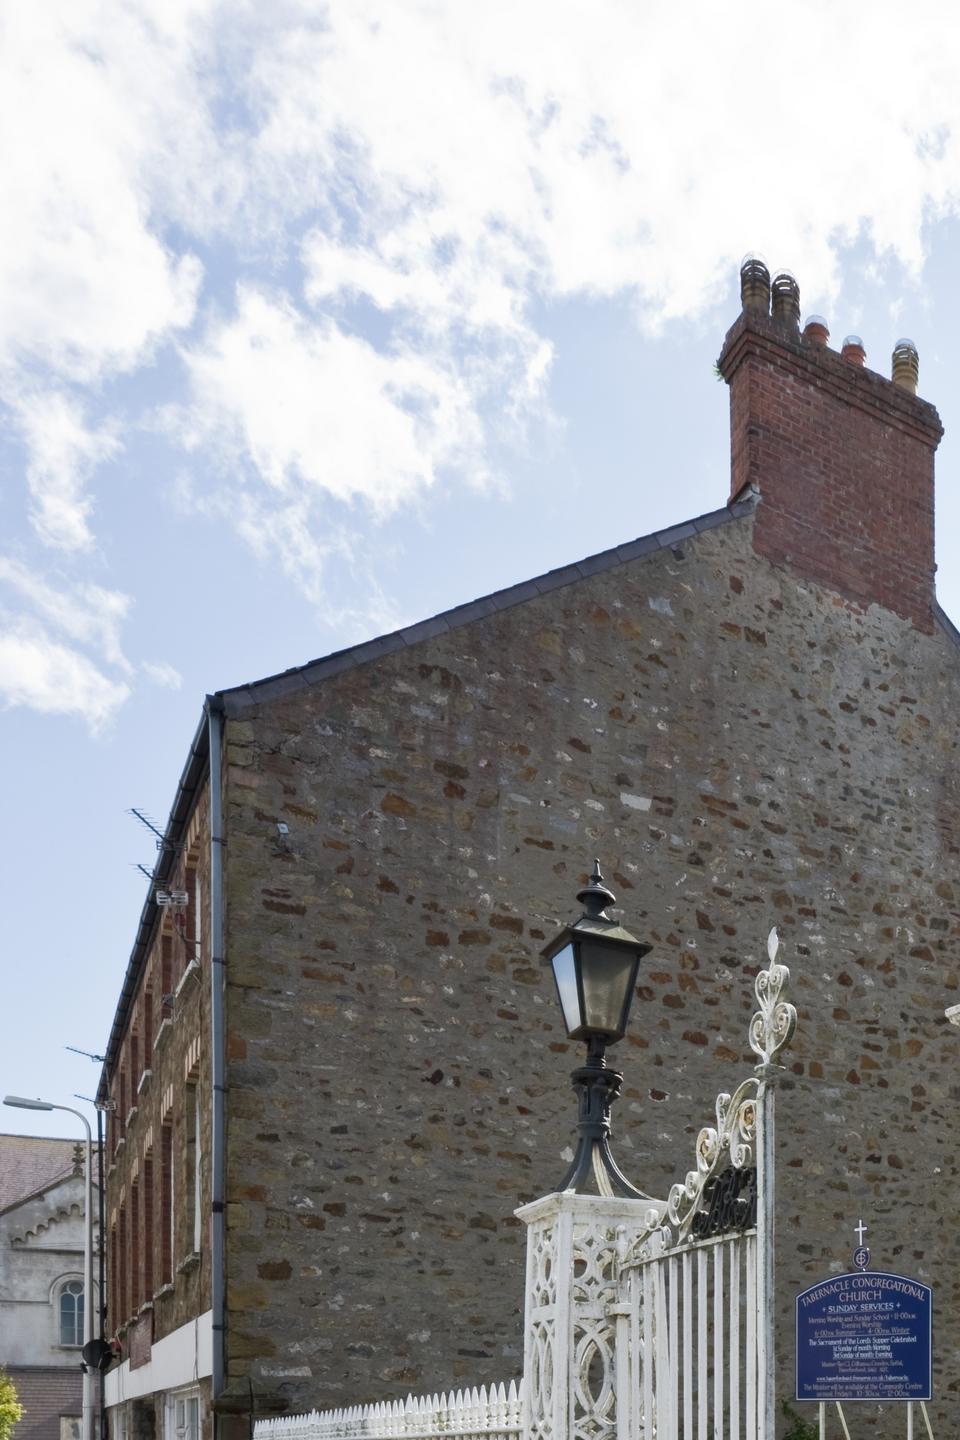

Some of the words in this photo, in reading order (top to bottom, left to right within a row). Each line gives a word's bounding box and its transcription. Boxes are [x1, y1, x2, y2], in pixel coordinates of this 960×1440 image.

[801, 1279, 850, 1307] TABERNACLE
[851, 1277, 926, 1302] CONGREGATIONAL
[838, 1290, 882, 1302] CHURCH
[828, 1304, 858, 1312] SUNDAY
[860, 1302, 894, 1310] SERVICES
[854, 1315, 871, 1323] Sunday
[817, 1338, 842, 1346] Sacrament
[872, 1337, 890, 1345] Supper
[838, 1345, 852, 1353] Sunday
[839, 1352, 854, 1360] Sunday
[875, 1351, 893, 1359] Evening
